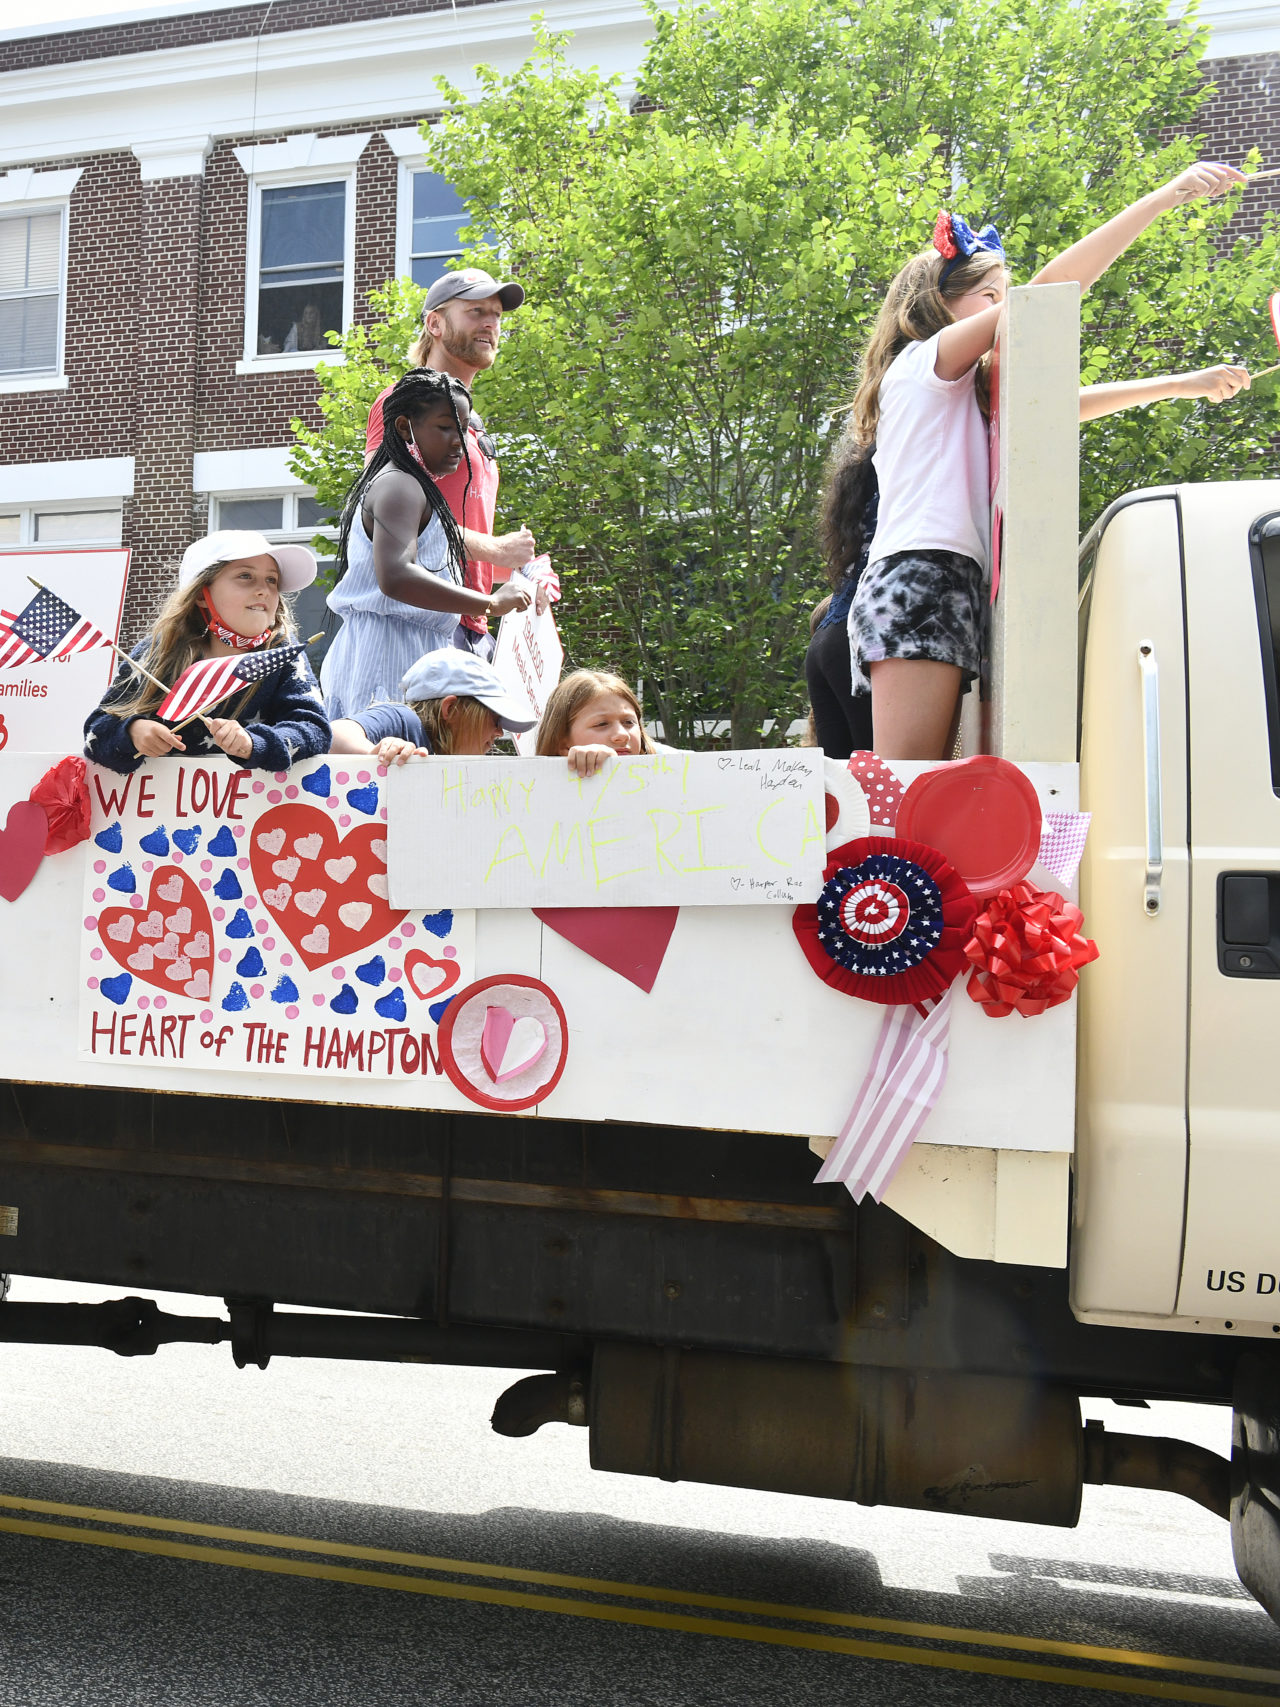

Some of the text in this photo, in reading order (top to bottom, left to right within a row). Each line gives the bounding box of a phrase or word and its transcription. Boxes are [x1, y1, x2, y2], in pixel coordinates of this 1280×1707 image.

[93, 767, 254, 820] WE LOVE
[91, 1010, 195, 1059] HEART
[199, 1025, 234, 1056] of
[242, 1022, 289, 1064] THE
[1206, 1269, 1280, 1295] US D
